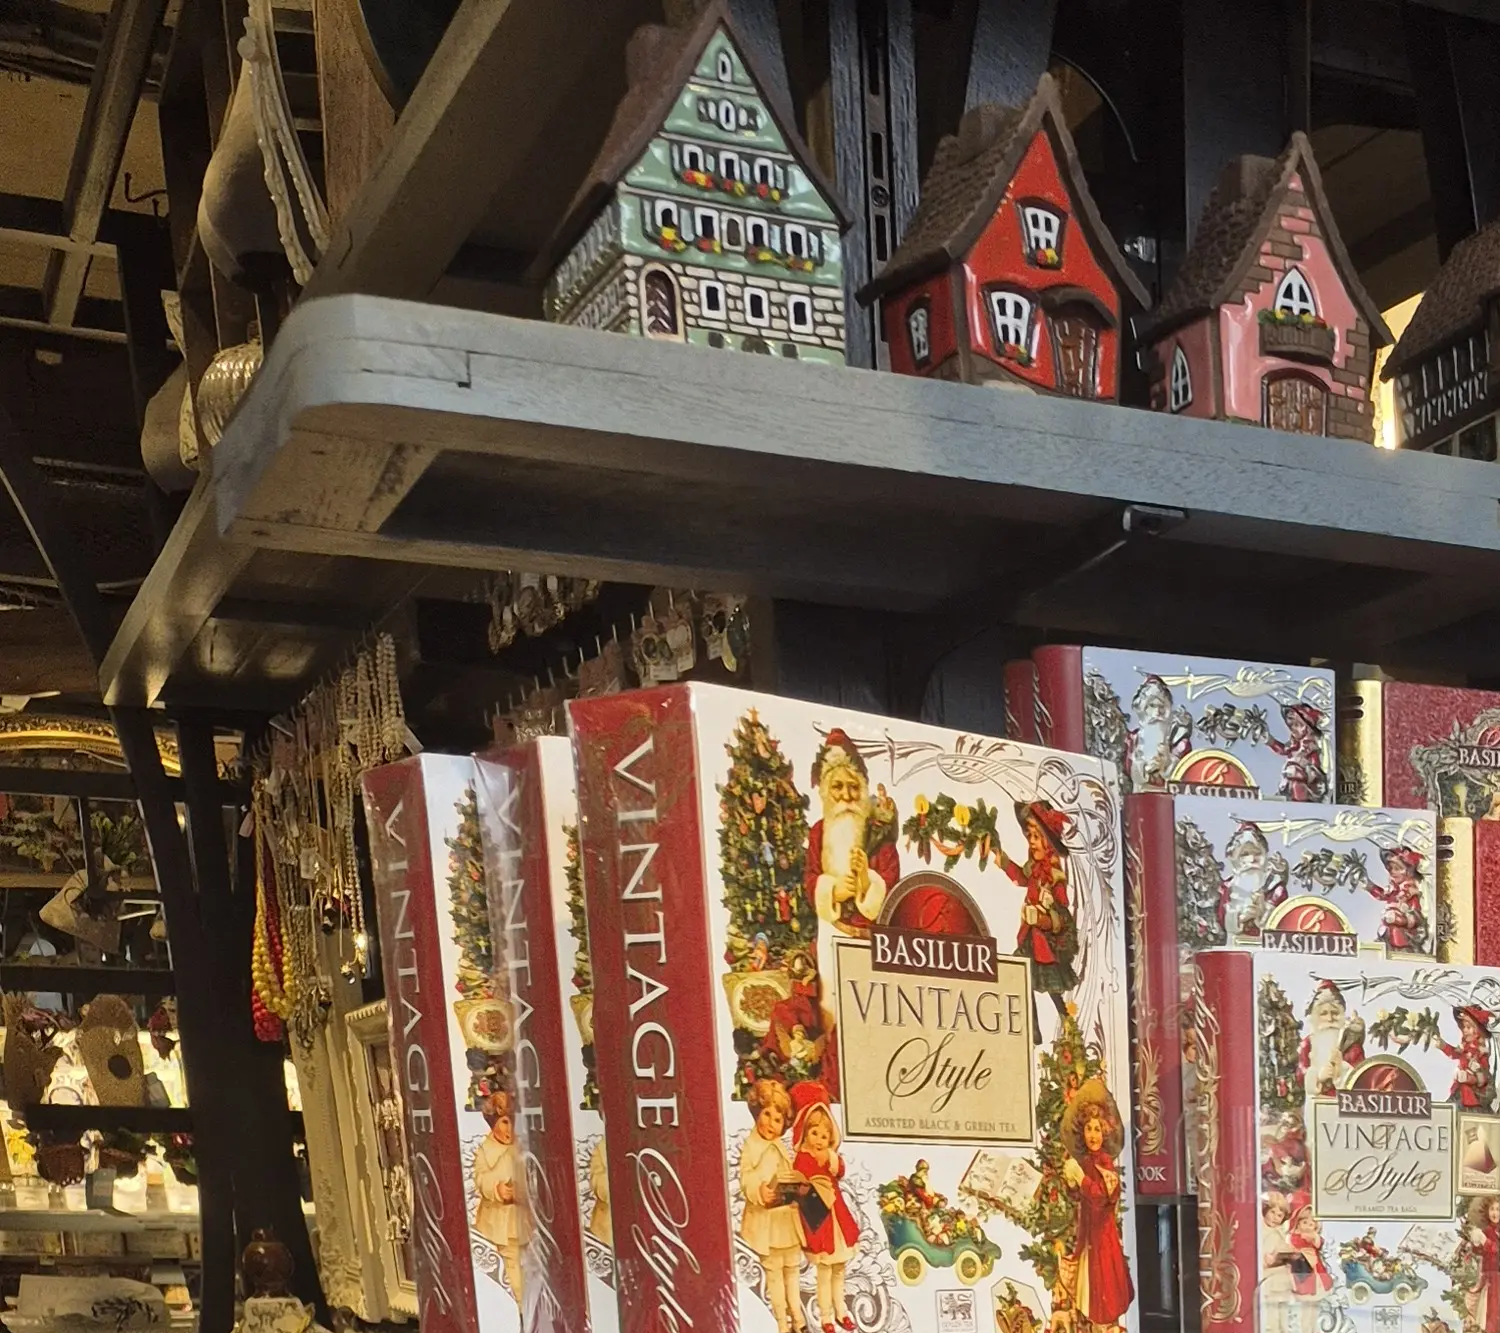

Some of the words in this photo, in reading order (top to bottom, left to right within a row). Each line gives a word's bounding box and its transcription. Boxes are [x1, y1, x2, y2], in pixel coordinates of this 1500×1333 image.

[612, 736, 680, 1130] VINTAGE
[874, 932, 994, 976] BASILUR
[1263, 931, 1358, 956] BASILUR
[384, 803, 434, 1135] VINTAGE
[847, 980, 1023, 1036] VINTAGE
[885, 1032, 992, 1113] Style
[865, 1118, 915, 1130] ASSORTED
[919, 1119, 951, 1131] BLACK
[954, 1120, 960, 1131] &
[964, 1120, 996, 1132] GREEN
[999, 1122, 1017, 1133] TEA
[1340, 1093, 1430, 1115] BASILUR
[1322, 1122, 1449, 1152] VINTAGE
[1344, 1155, 1421, 1204] Style
